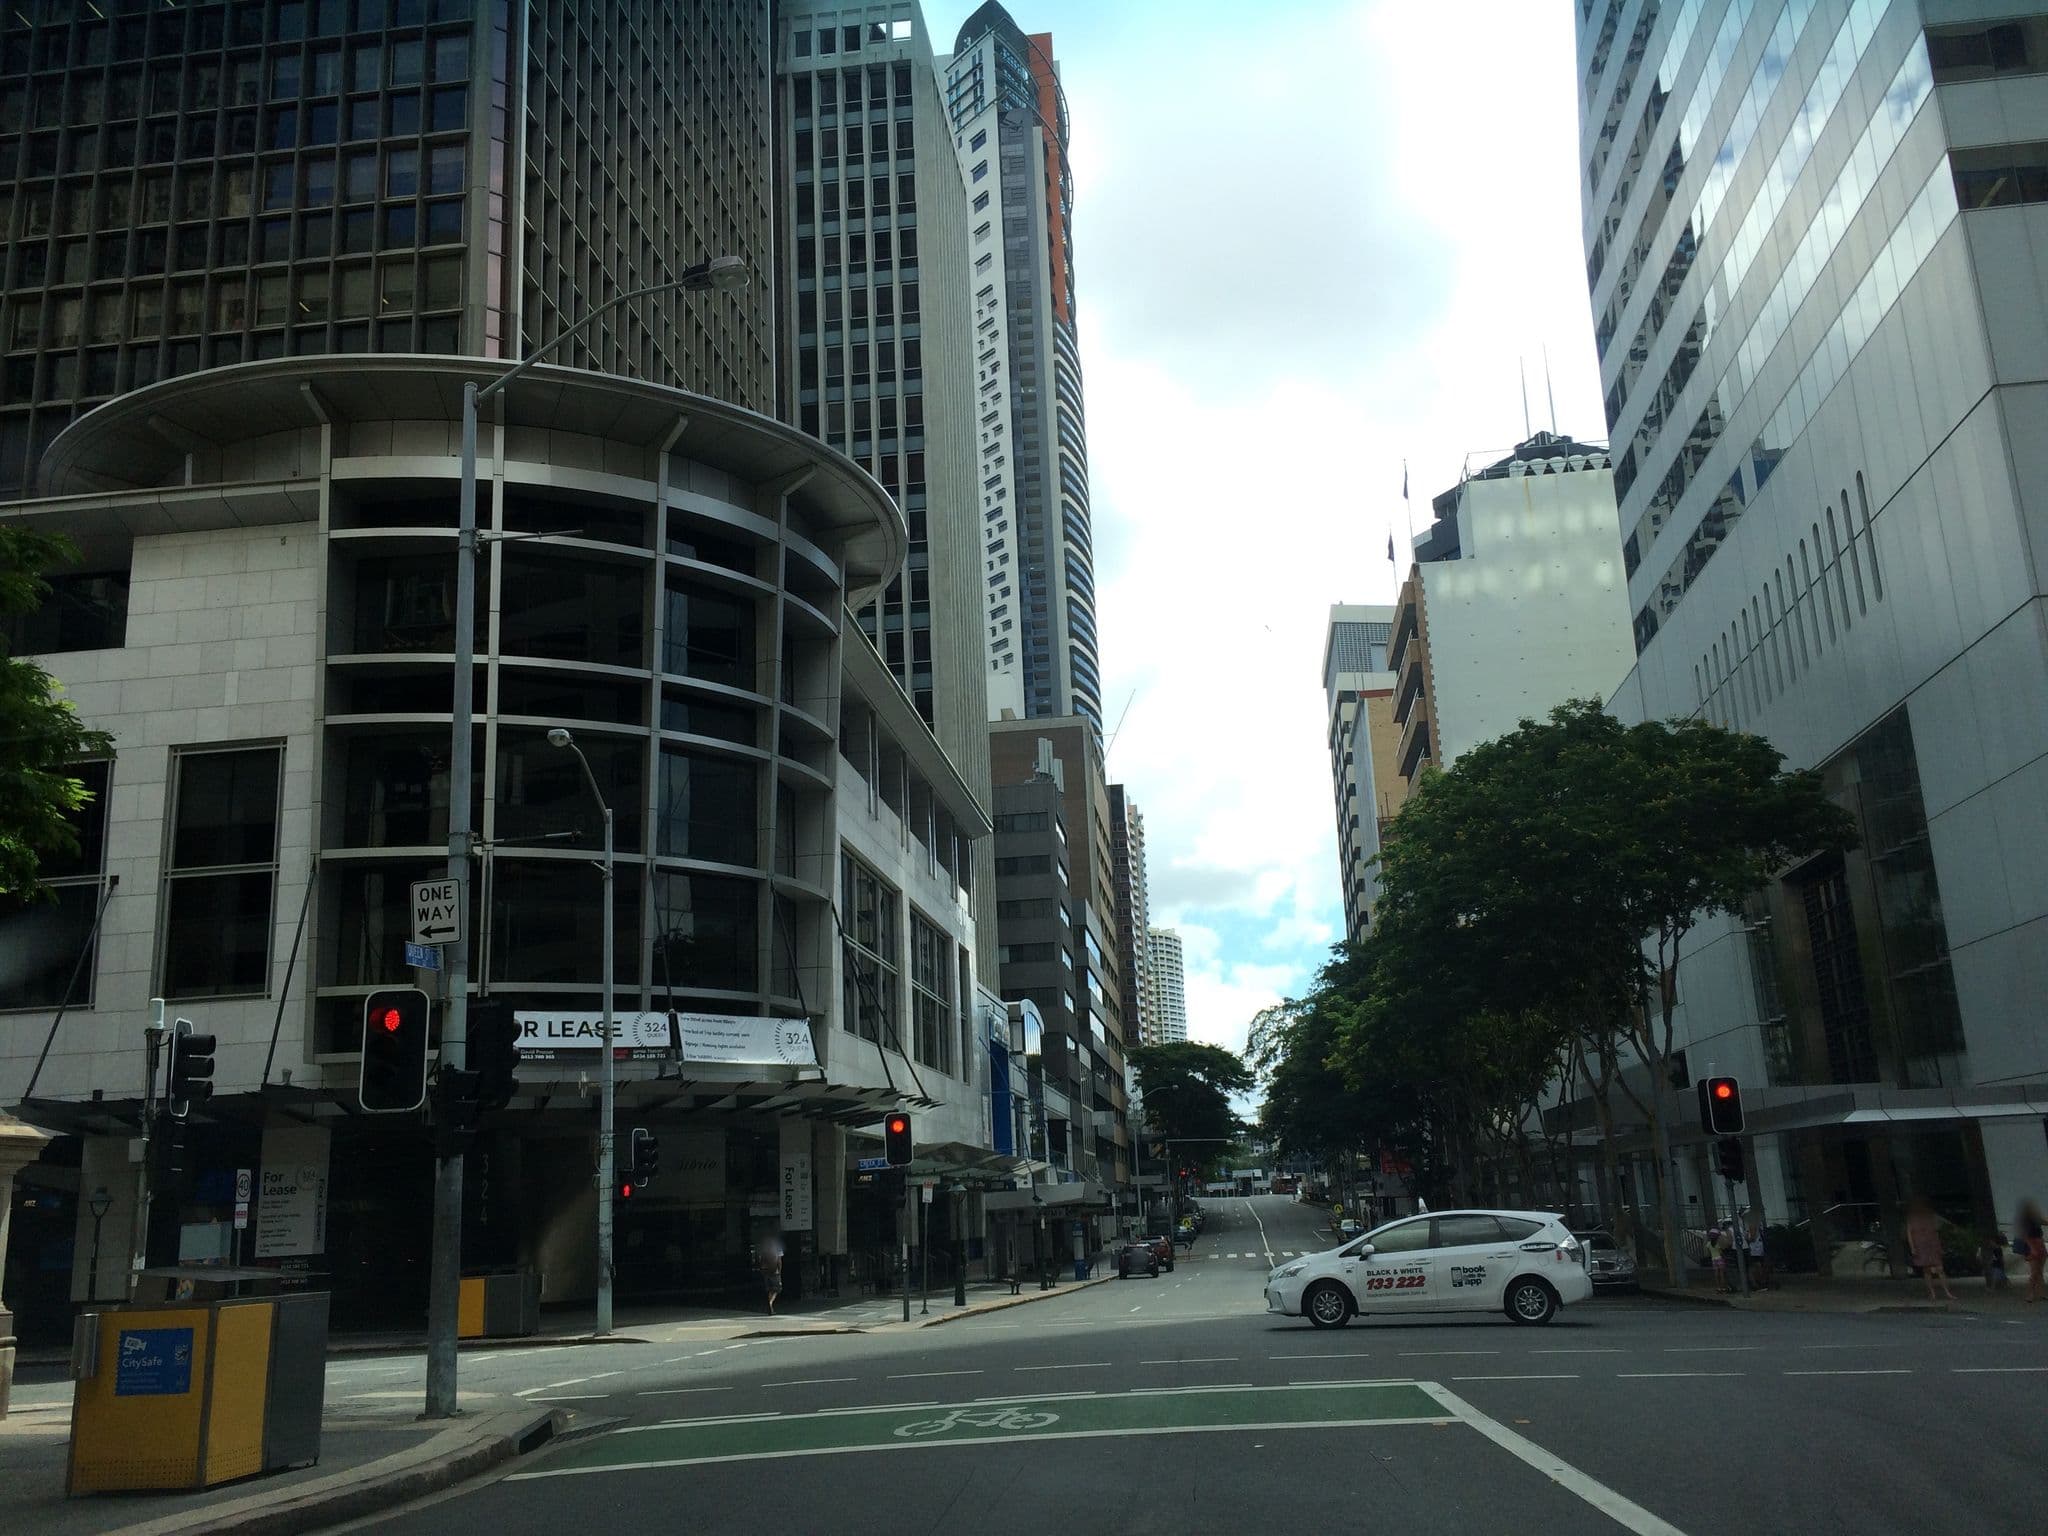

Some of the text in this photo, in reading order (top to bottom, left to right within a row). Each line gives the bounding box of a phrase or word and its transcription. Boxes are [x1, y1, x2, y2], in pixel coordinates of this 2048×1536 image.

[420, 886, 453, 902] ONE
[418, 905, 455, 921] WAY
[548, 1020, 623, 1038] LEASE
[644, 1022, 667, 1033] 324
[786, 1032, 809, 1045] 324
[263, 1171, 285, 1183] For
[238, 1178, 249, 1190] 40
[263, 1185, 297, 1197] Lease
[784, 1167, 794, 1220] For Lease
[1366, 1269, 1391, 1277] BLACK
[1400, 1267, 1424, 1275] WHITE
[1462, 1265, 1486, 1274] book
[1366, 1275, 1426, 1291] 133 222
[1464, 1279, 1482, 1287] app
[122, 1356, 163, 1370] CitySafe
